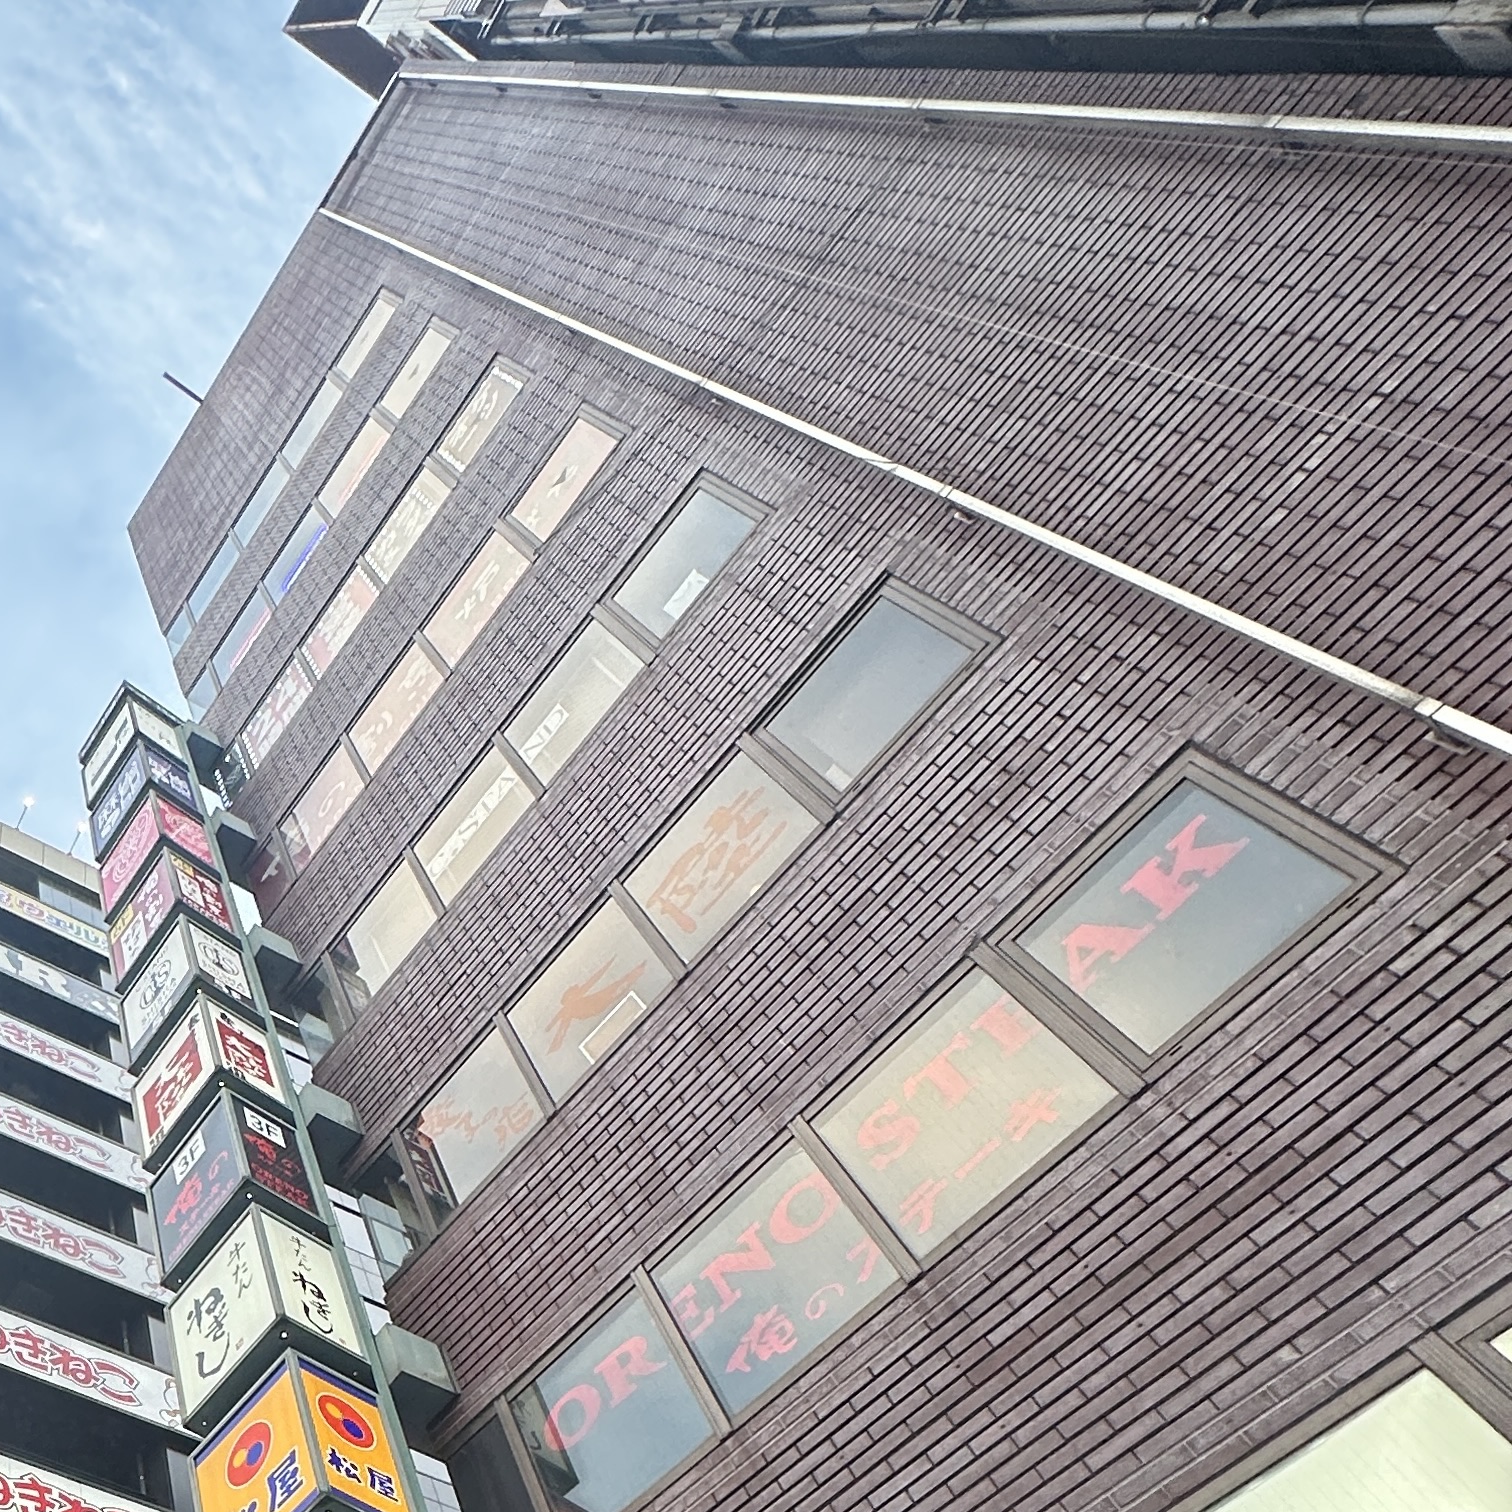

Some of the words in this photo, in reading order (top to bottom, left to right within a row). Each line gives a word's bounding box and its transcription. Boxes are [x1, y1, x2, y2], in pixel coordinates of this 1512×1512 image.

[250, 1115, 279, 1142] 3F
[176, 1139, 201, 1177] 3F
[227, 1241, 254, 1298] 牛たん
[292, 1271, 333, 1335] ねぎし
[186, 1287, 232, 1379] ねぎし
[327, 1446, 401, 1504] 松屋
